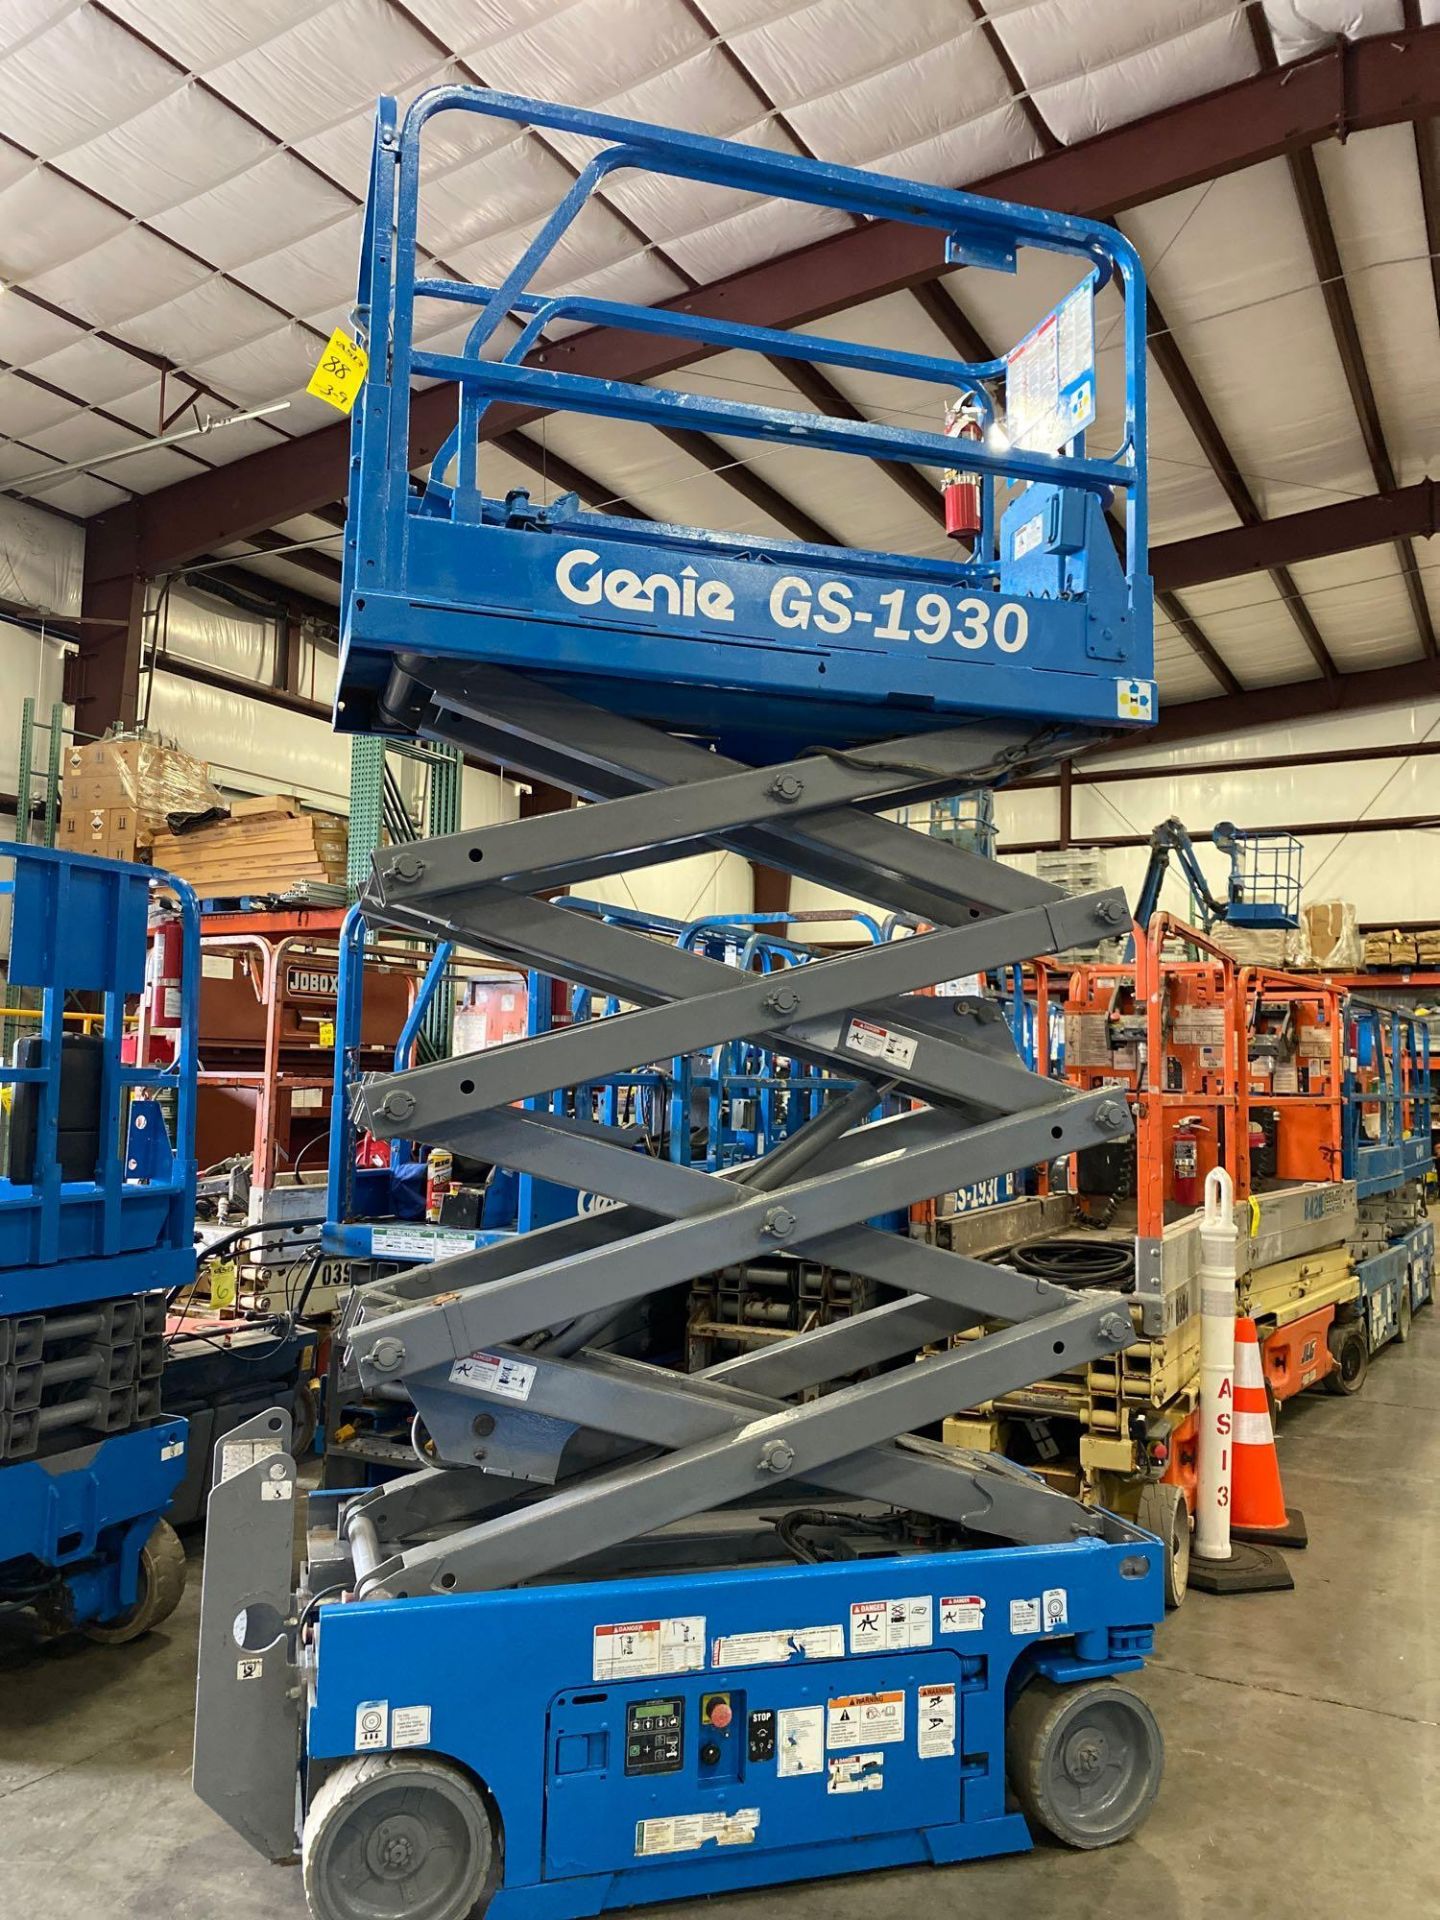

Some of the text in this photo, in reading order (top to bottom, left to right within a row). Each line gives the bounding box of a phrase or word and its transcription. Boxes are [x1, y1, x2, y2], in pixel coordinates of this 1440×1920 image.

[322, 355, 352, 380] 88
[556, 549, 1029, 653] Genie GS-1930
[290, 971, 340, 994] JOBOX
[953, 1176, 999, 1212] S-193
[216, 1284, 229, 1300] 6
[860, 1602, 886, 1612] DANGER
[619, 1624, 644, 1633] DANGER
[752, 1712, 772, 1723] STOP
